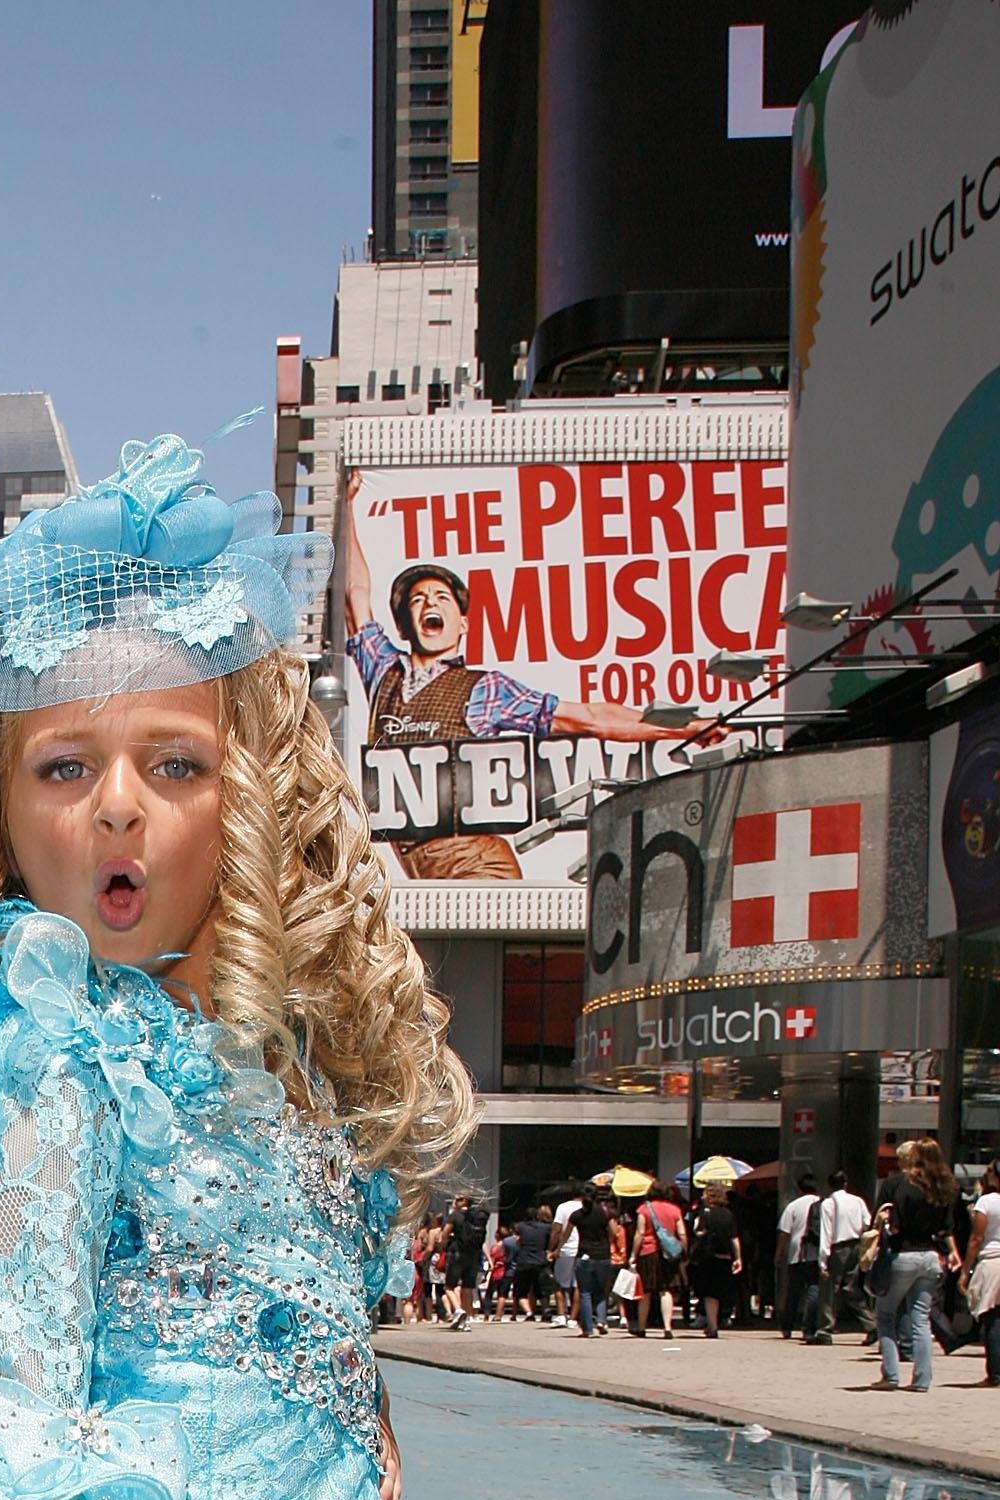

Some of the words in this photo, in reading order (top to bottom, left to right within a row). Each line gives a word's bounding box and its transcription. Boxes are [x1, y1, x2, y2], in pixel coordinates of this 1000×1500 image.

[755, 233, 791, 246] ww
[518, 461, 788, 561] PERFE
[579, 661, 656, 706] FOR
[366, 728, 784, 830] NEWS
[636, 1001, 781, 1052] swatch
